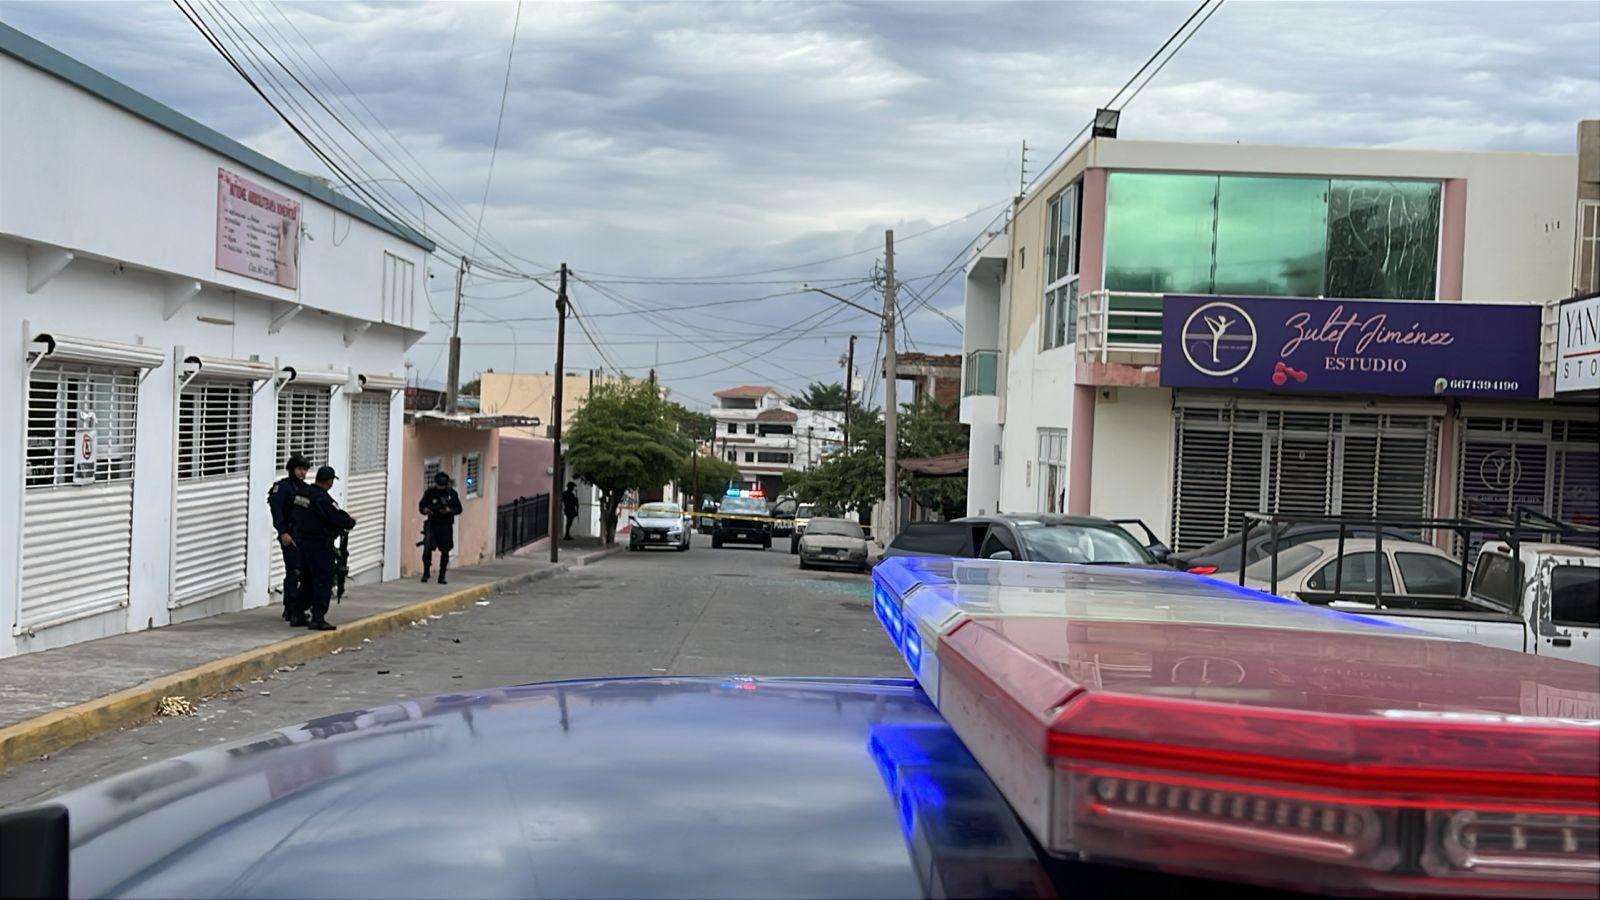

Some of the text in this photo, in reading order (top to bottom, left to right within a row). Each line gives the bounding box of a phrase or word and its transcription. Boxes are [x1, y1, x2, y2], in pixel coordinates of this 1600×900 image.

[1280, 304, 1454, 357] Zulet Jiménez
[1565, 305, 1600, 348] YAN
[1325, 356, 1407, 372] ESTUDIO
[1450, 379, 1519, 391] 6671394190
